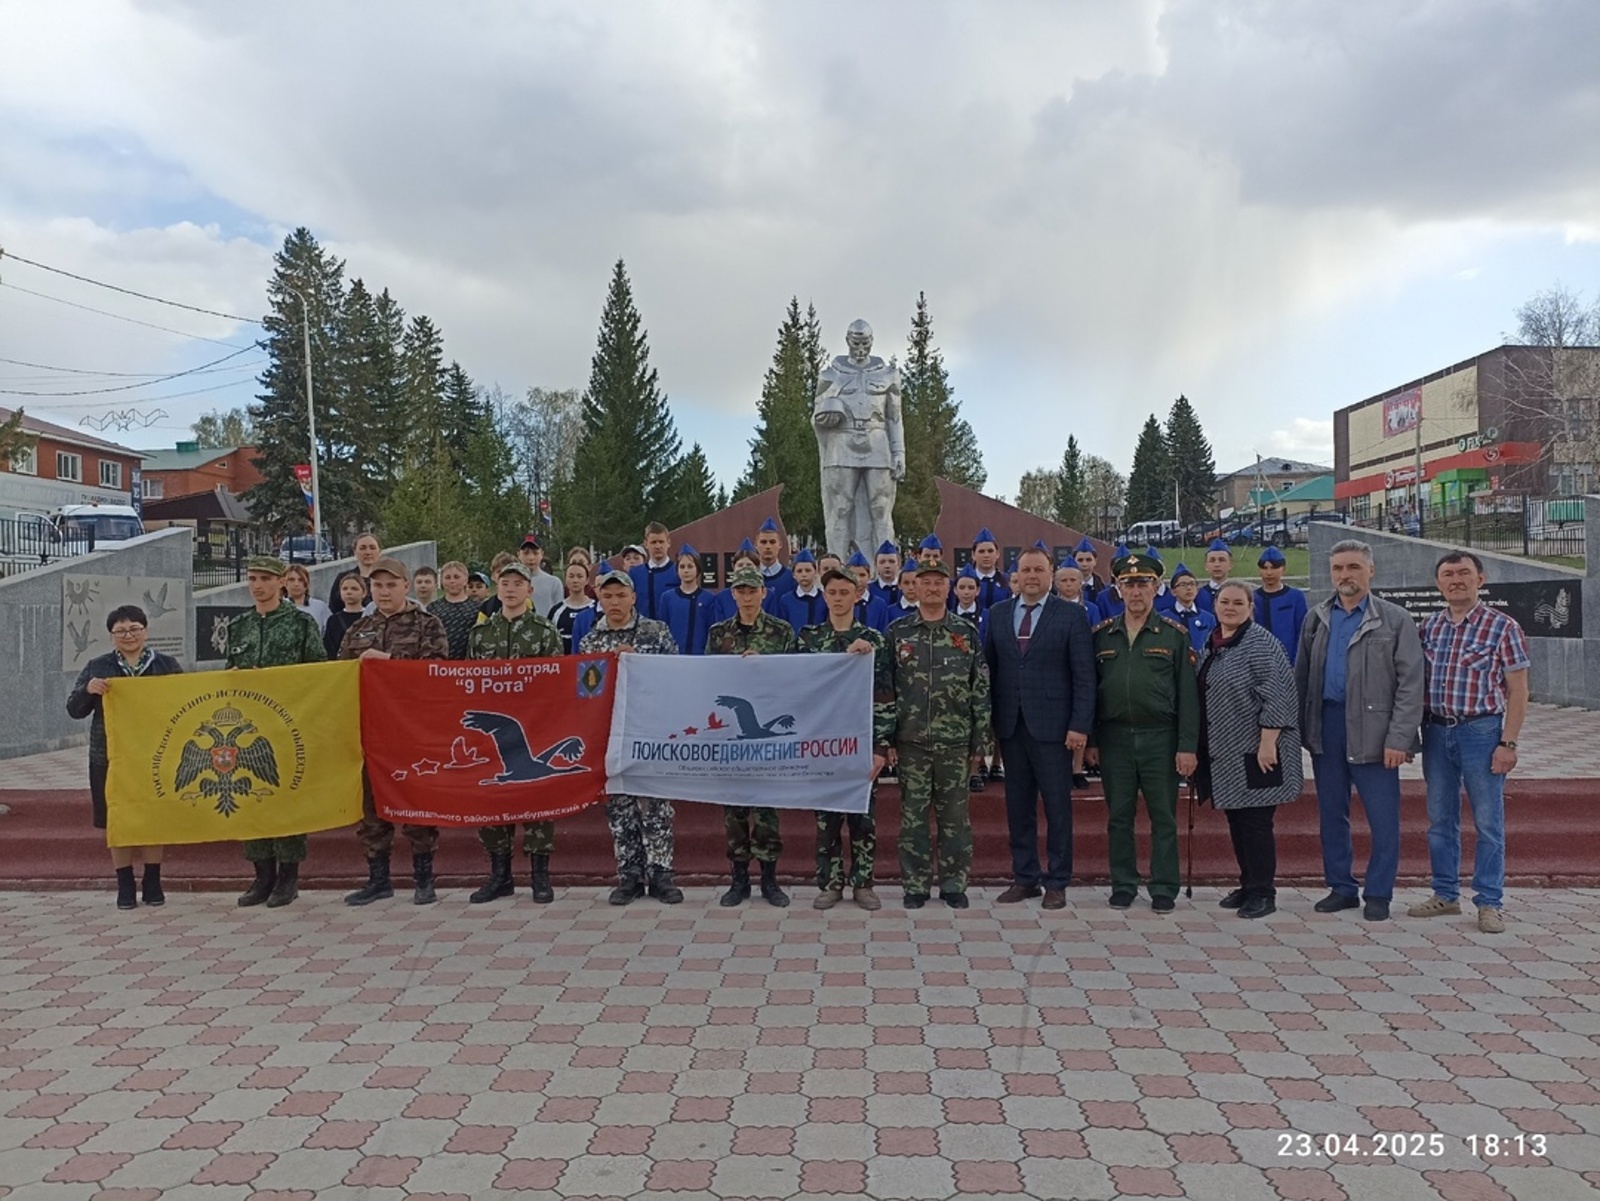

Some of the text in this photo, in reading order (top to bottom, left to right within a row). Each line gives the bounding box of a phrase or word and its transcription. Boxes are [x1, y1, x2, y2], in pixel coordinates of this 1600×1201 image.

[428, 662, 560, 677] Поисковый отряд
[151, 688, 307, 799] РОССИЙСКОЕ ВОЕННО-ИСТОРИЧЕСКОЕ ОБЩЕСТВО
